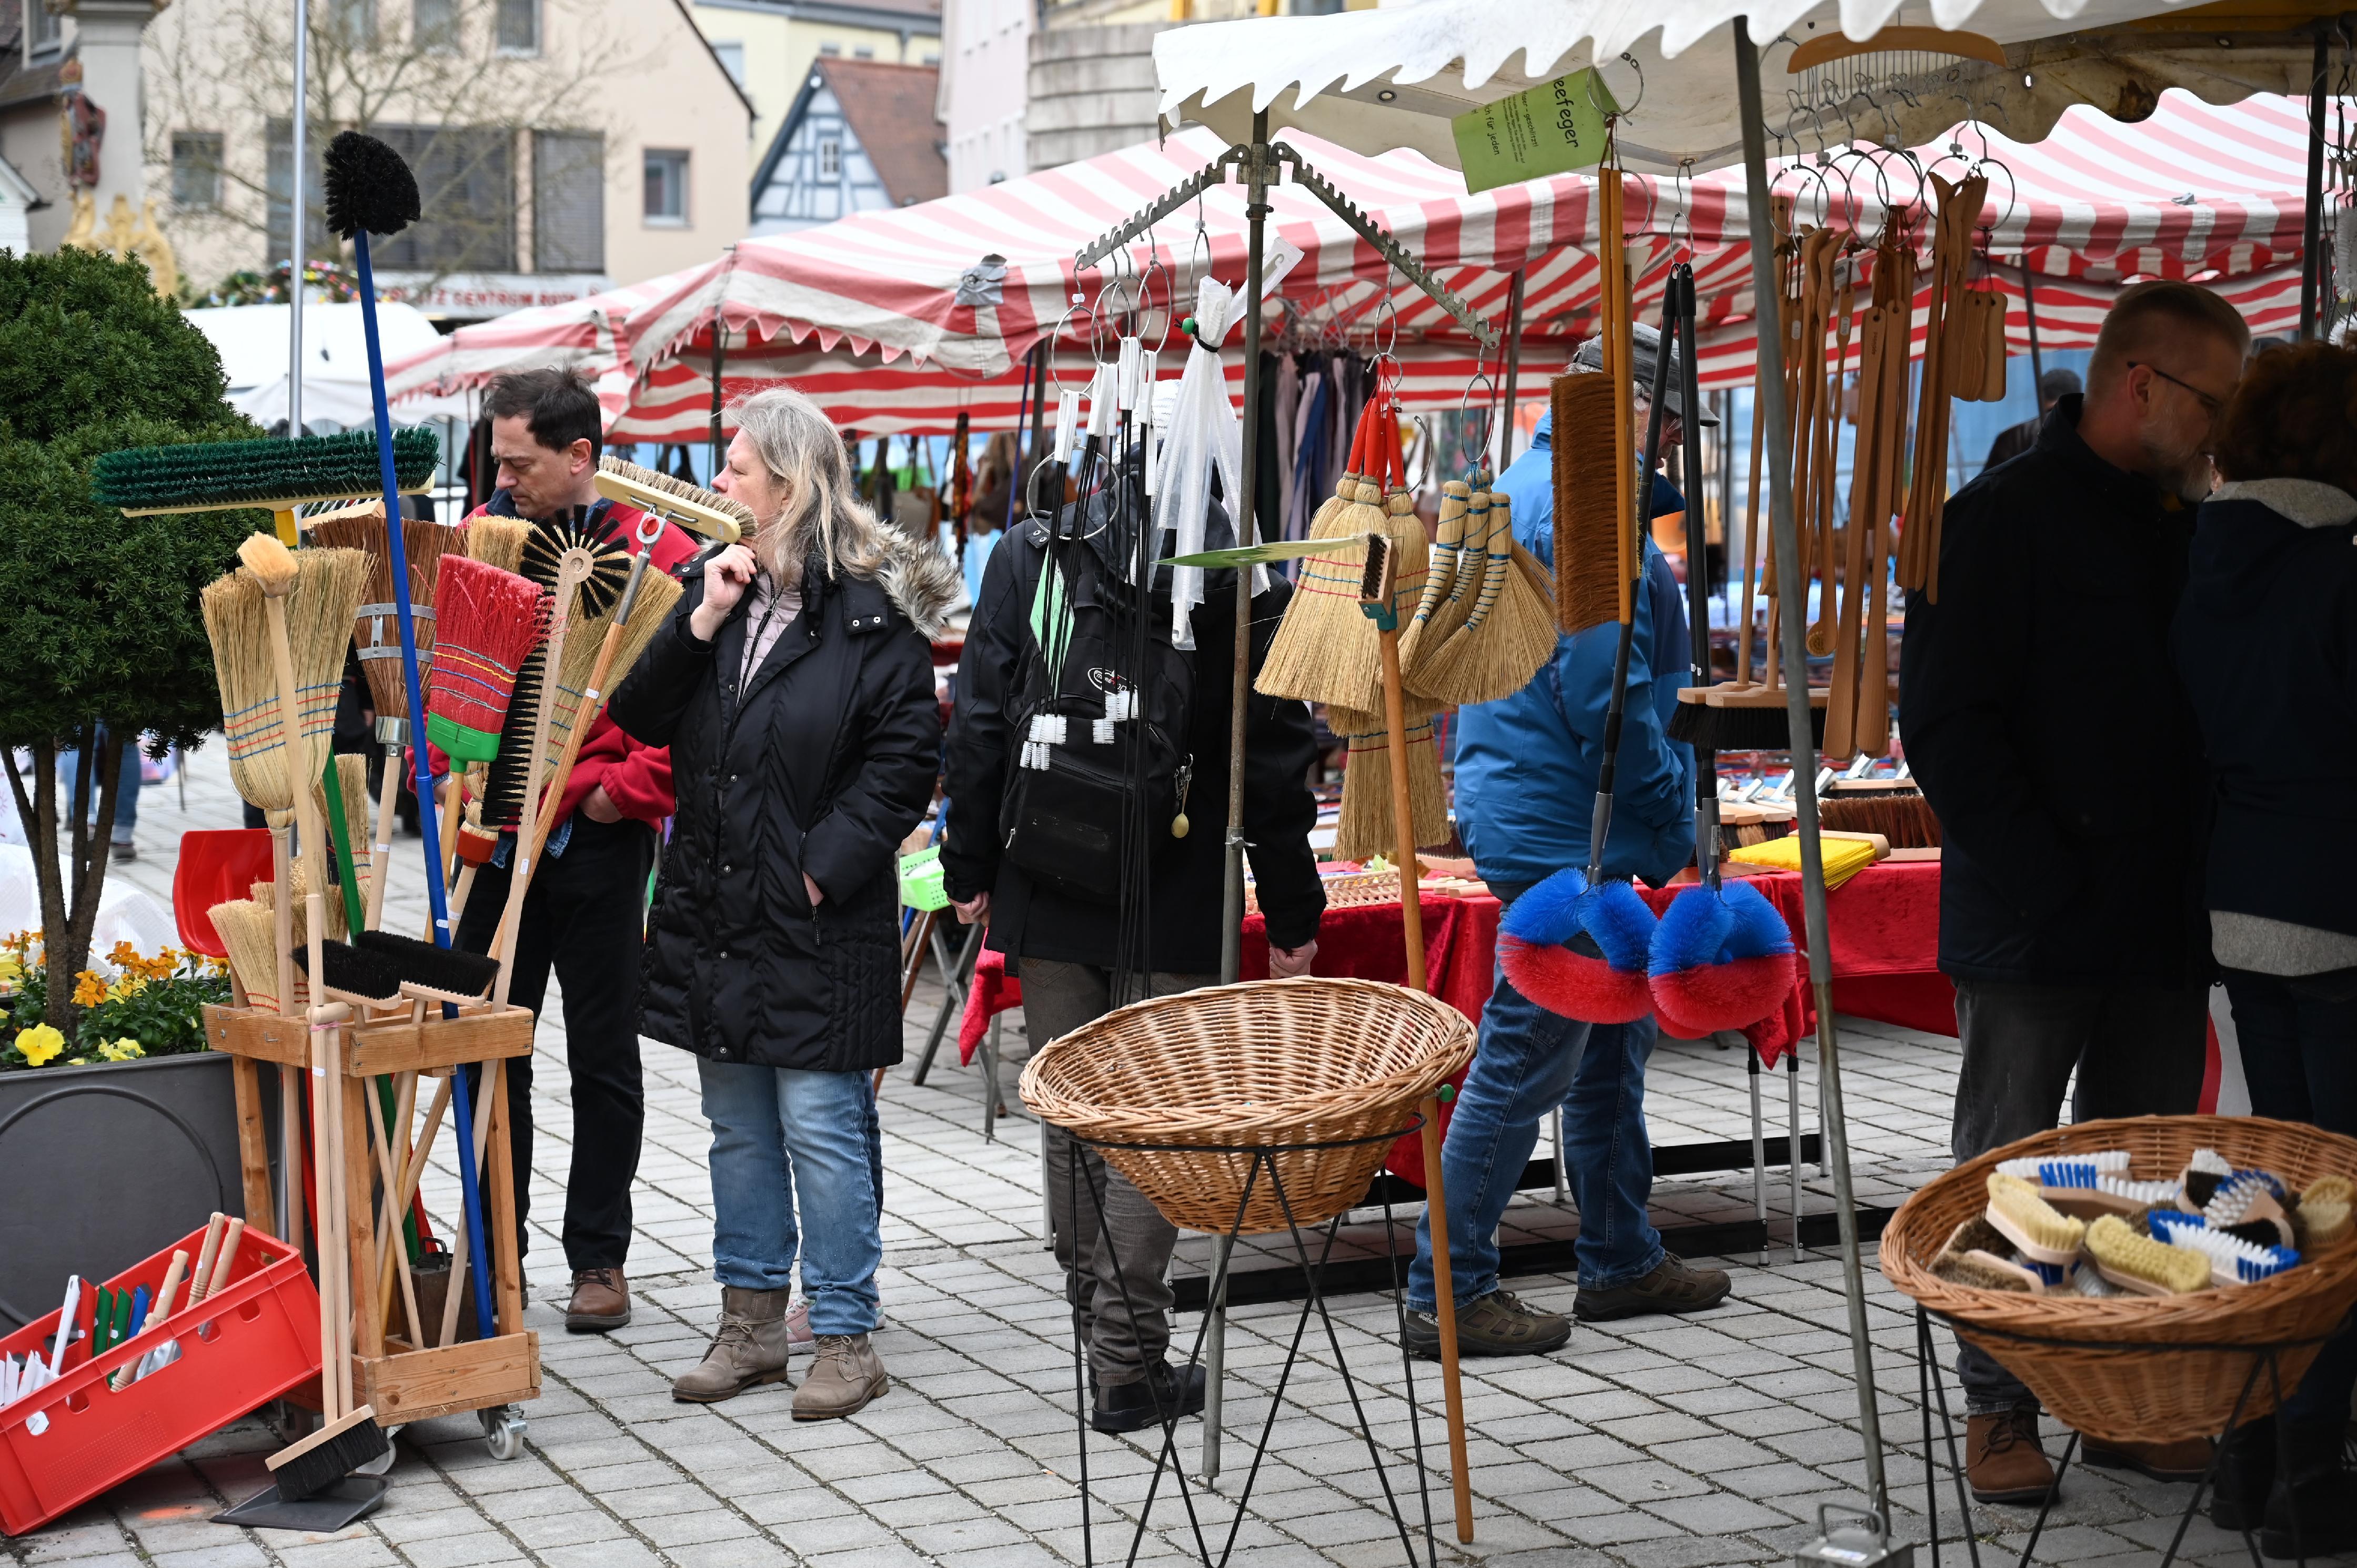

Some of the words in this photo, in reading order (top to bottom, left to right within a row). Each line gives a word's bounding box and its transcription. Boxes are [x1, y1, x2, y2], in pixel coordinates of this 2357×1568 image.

[1553, 76, 1578, 147] eefeger
[1485, 116, 1494, 129] für
[1487, 133, 1499, 155] jeden
[1418, 1313, 1439, 1328] Wolfskin
